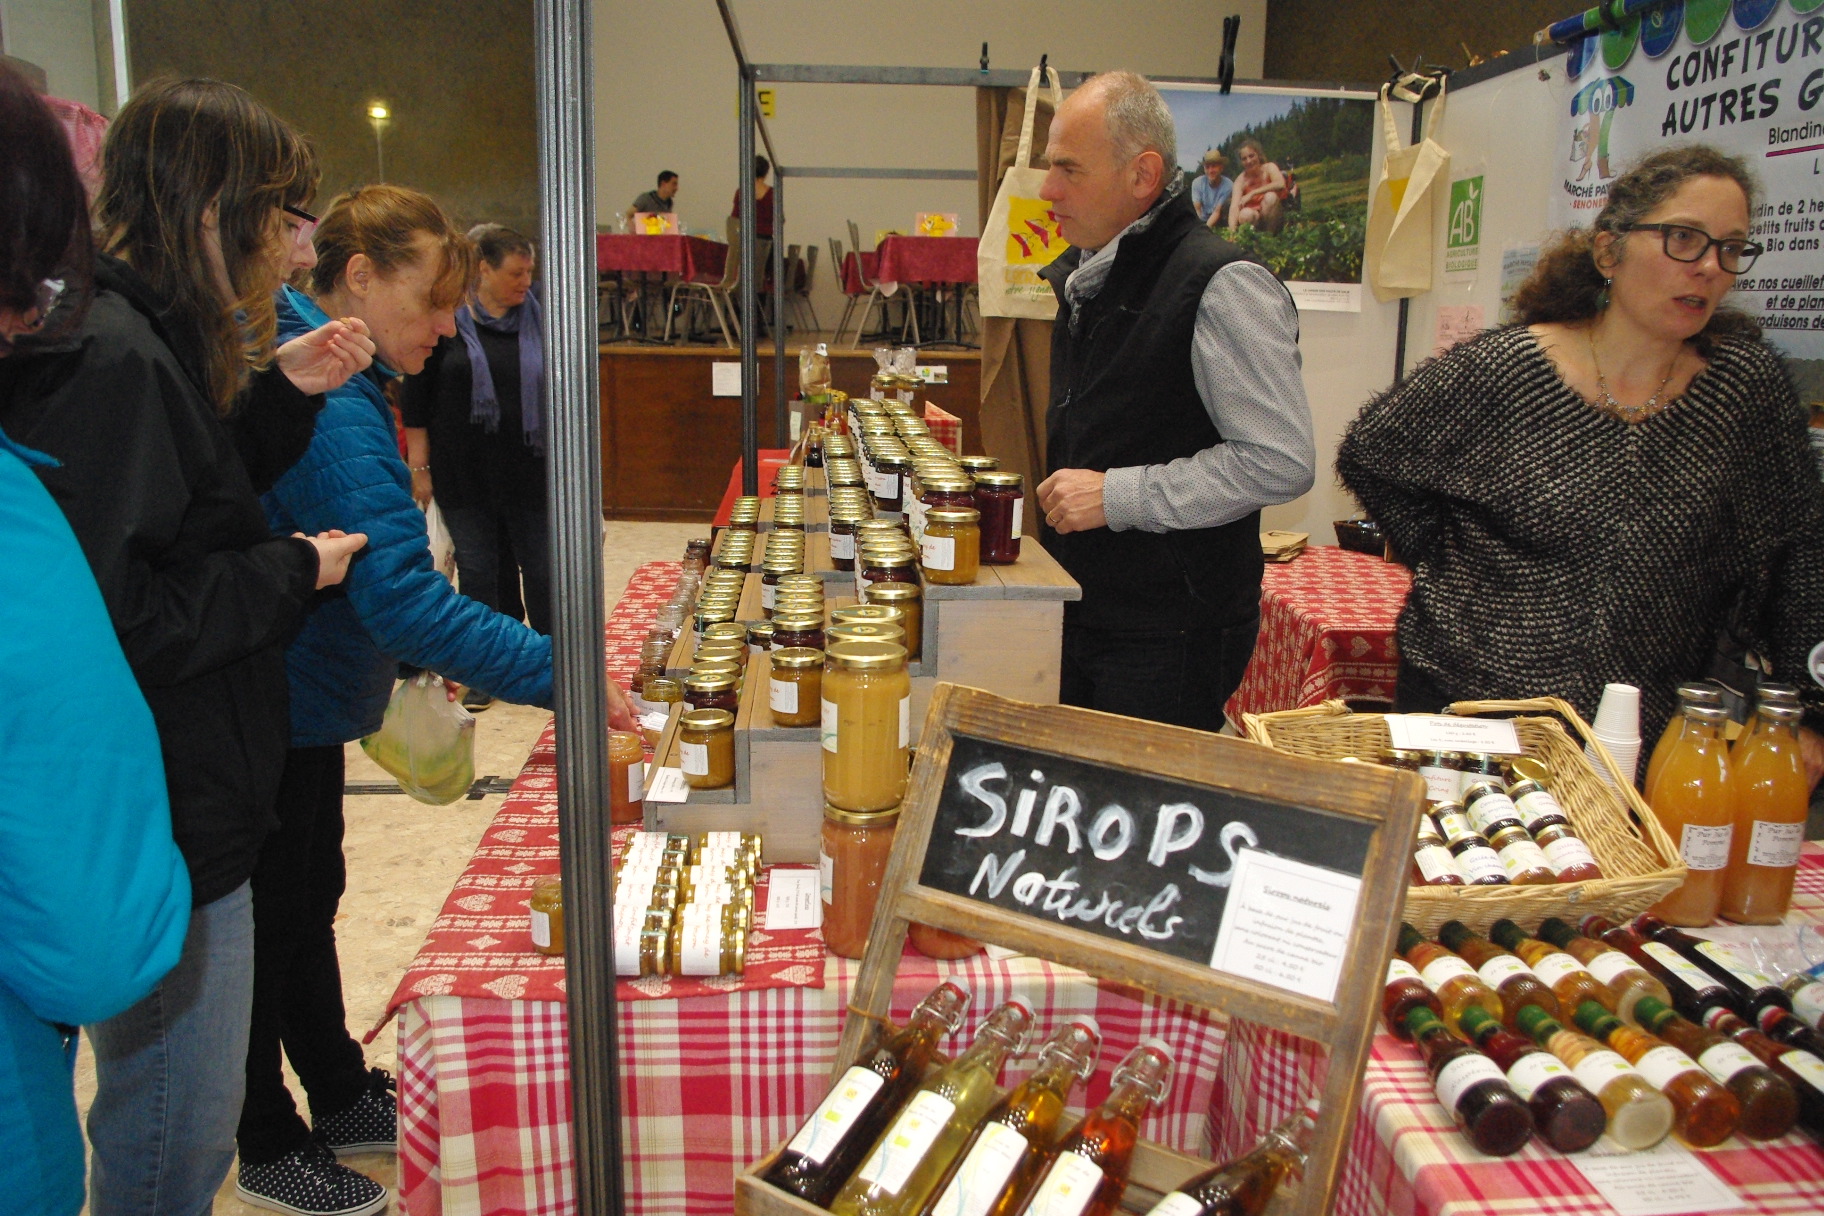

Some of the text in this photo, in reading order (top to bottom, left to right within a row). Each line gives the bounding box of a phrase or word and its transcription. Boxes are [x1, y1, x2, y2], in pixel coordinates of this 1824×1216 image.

[1666, 15, 1824, 91] CONFITUR
[1661, 78, 1781, 137] AUTRES
[1564, 179, 1611, 198] MARCHÉ PAY
[1751, 203, 1774, 218] din
[1778, 202, 1793, 216] de
[1797, 199, 1806, 215] 2
[1449, 199, 1475, 245] AB
[1748, 217, 1815, 239] petits fruits
[1766, 238, 1785, 253] Bio
[1788, 237, 1820, 252] dans
[1758, 278, 1778, 290] nos
[1766, 294, 1778, 309] et
[1780, 294, 1796, 309] de
[1756, 314, 1809, 329] roduisons
[954, 761, 1258, 889] SiROPS
[968, 848, 1183, 941] Naturels
